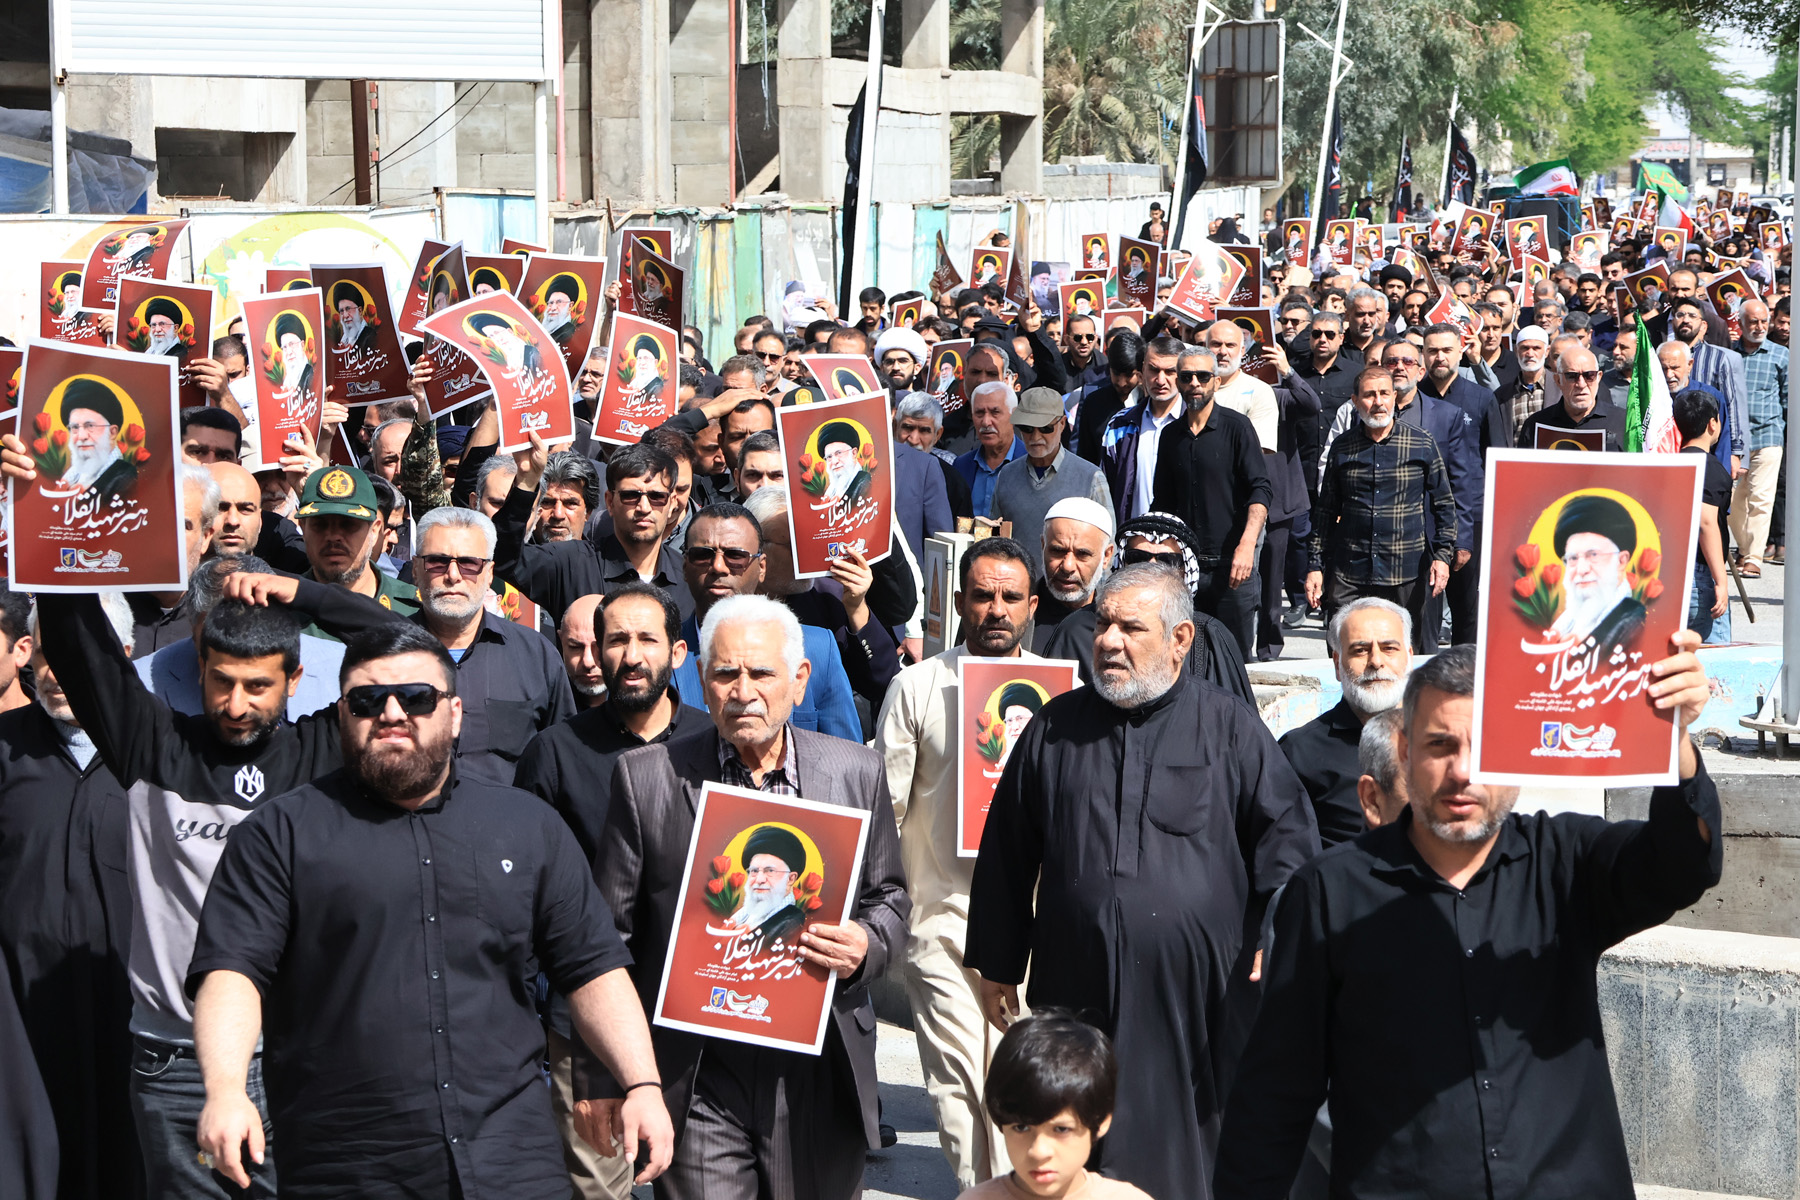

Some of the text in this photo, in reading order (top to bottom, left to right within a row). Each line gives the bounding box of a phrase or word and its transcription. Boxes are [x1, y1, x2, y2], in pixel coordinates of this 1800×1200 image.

[331, 343, 388, 375] رهبر شهید انقلاب
[272, 386, 303, 417] انقلاب
[618, 384, 647, 408] انقلاب
[40, 481, 148, 539] رهبر شهید انقلاب
[810, 495, 879, 533] رهبر شهید انقلاب
[1521, 631, 1652, 709] رهبر شهید انقلاب
[234, 765, 265, 802] NY
[175, 818, 235, 842] ya
[705, 919, 804, 981] رهبر شهید انقلاب
